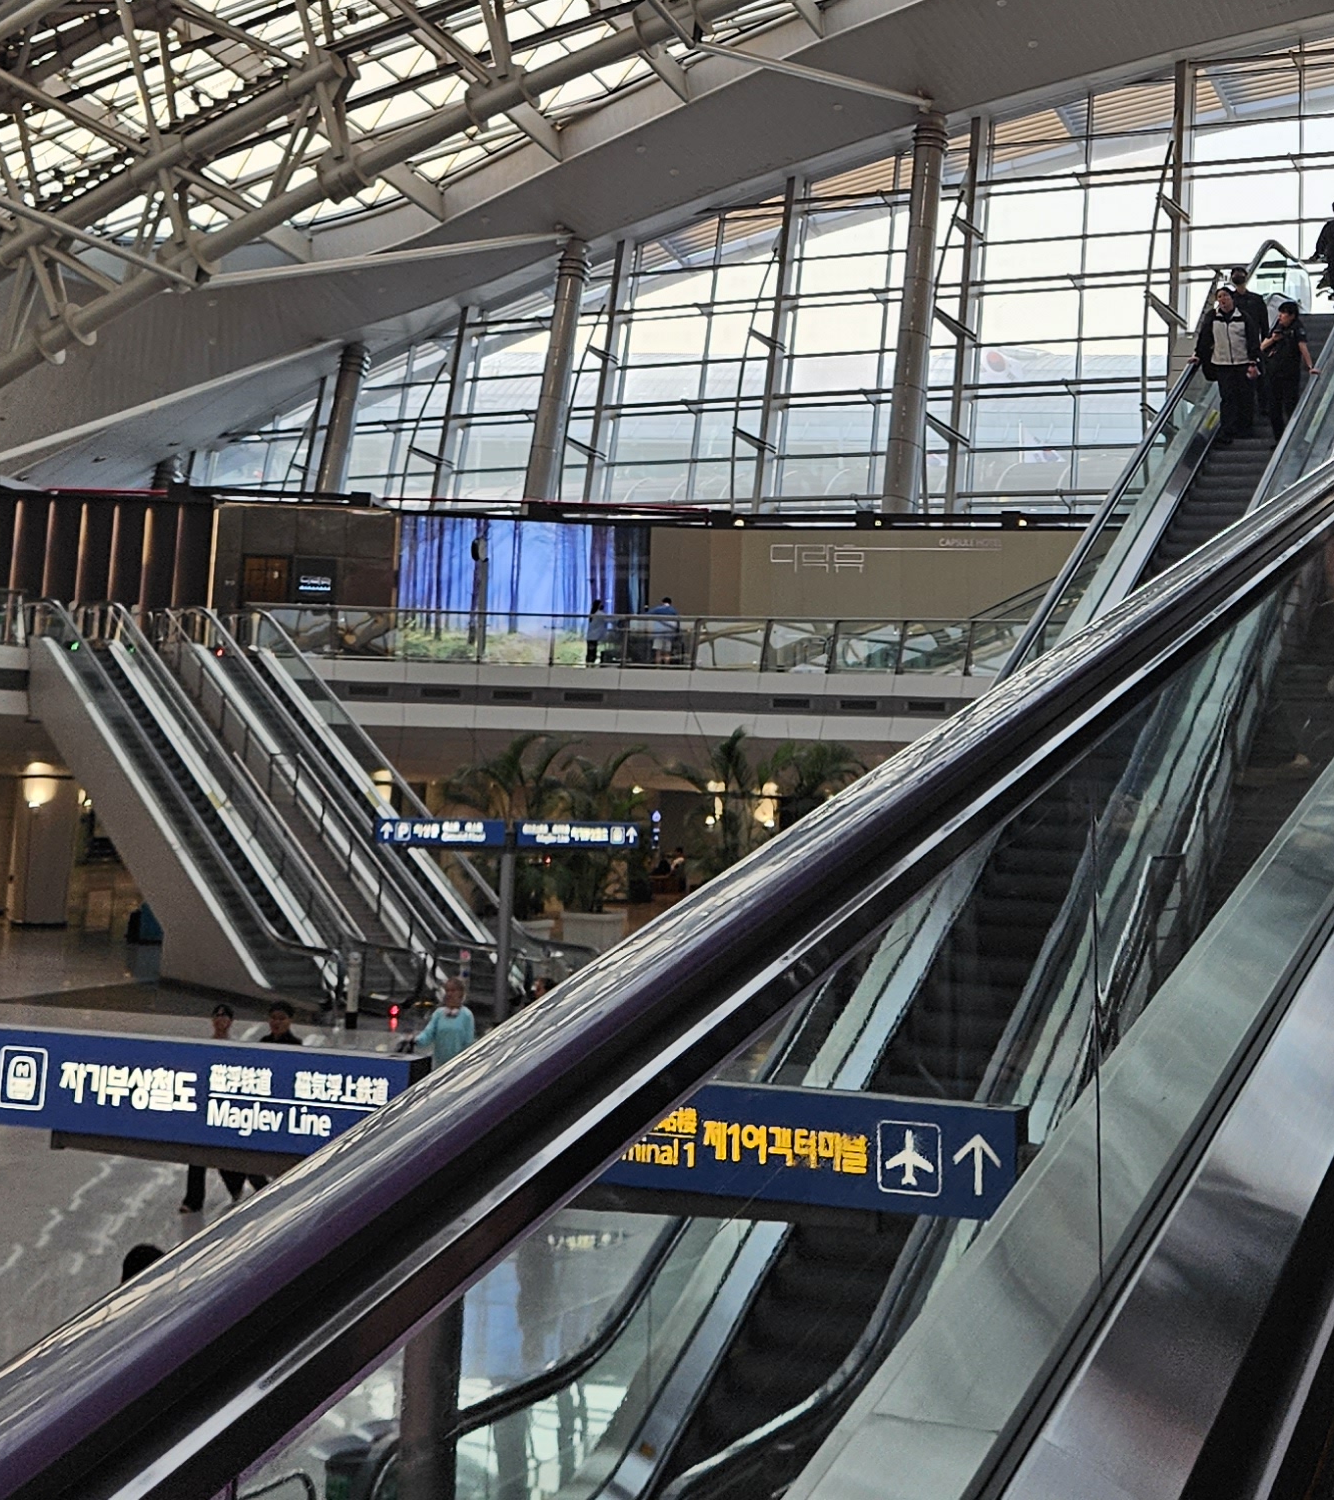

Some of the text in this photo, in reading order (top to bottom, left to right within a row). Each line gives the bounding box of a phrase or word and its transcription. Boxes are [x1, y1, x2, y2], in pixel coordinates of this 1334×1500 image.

[59, 1061, 197, 1112] 자기부상철도
[206, 1098, 332, 1138] Maglev Line
[682, 1141, 695, 1168] 1
